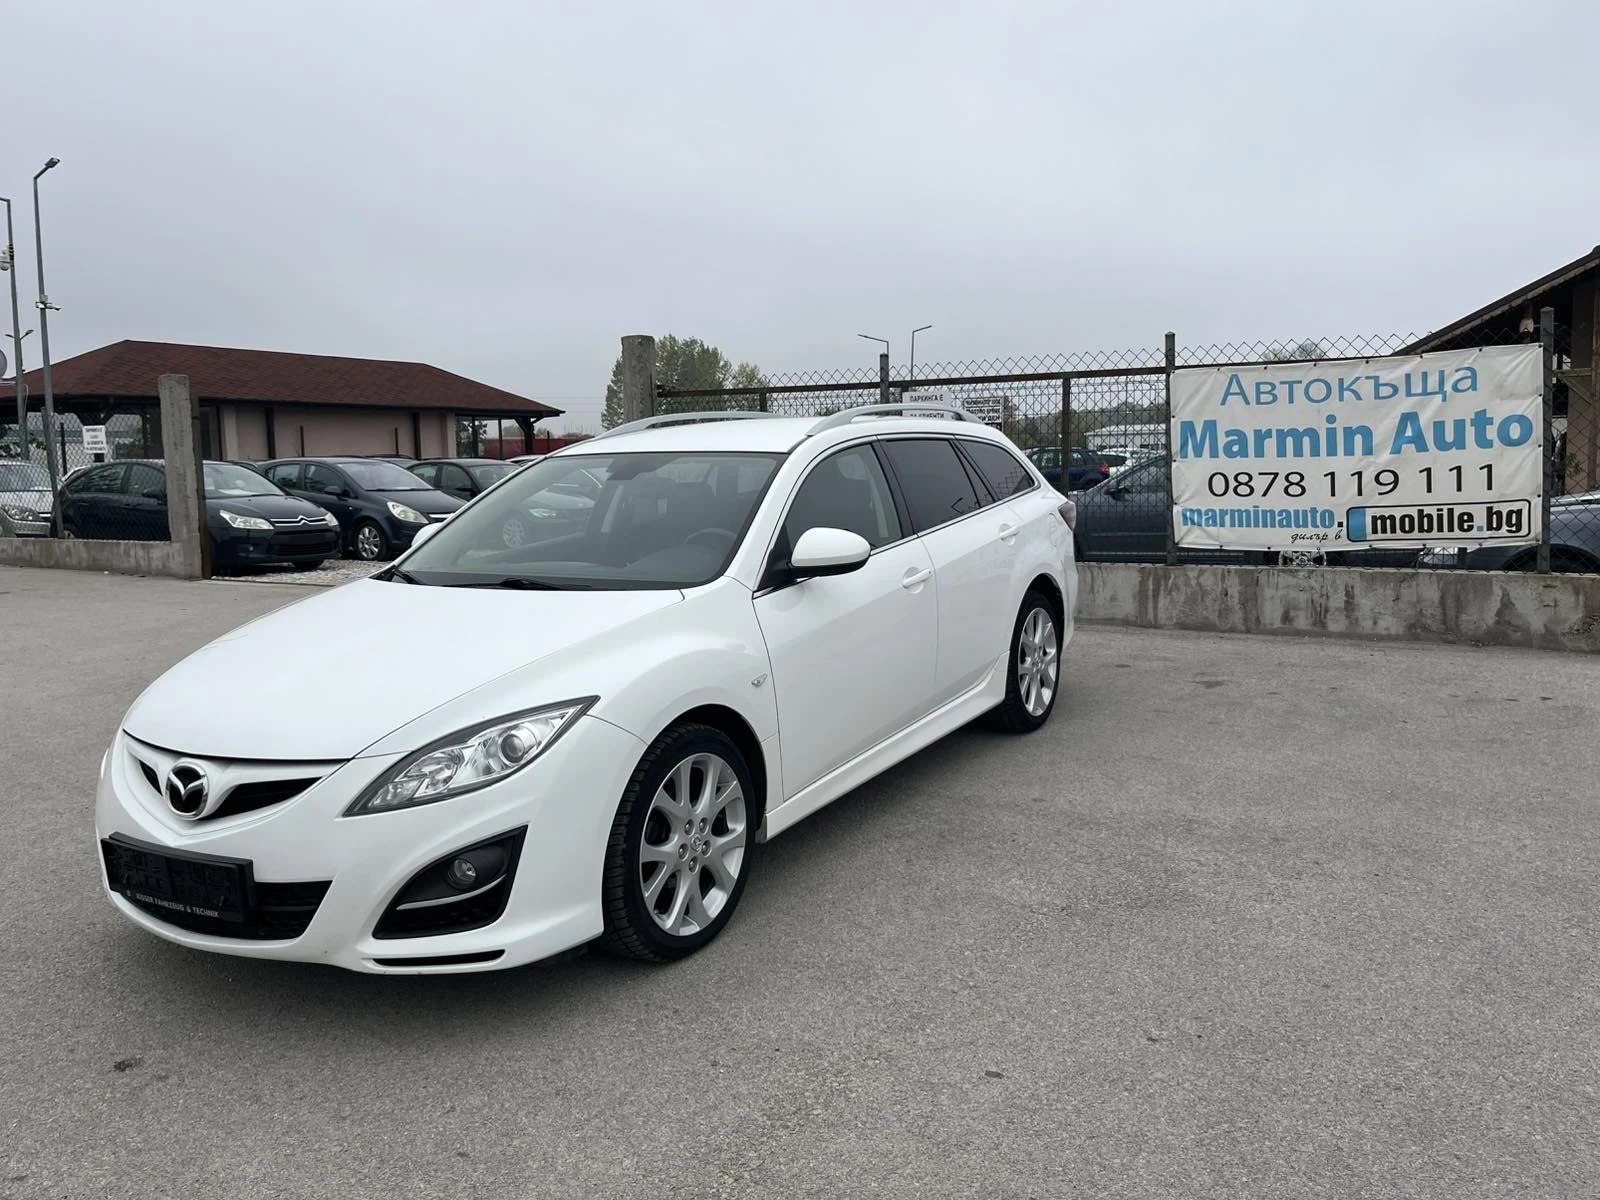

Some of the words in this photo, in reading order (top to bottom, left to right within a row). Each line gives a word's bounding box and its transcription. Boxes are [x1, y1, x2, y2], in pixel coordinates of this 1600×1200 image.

[1220, 365, 1478, 406] Автокъща
[1179, 414, 1374, 459] Marmin
[1389, 408, 1533, 456] Auto
[1207, 471, 1307, 497] 0878
[1323, 469, 1400, 497] 119
[1418, 463, 1494, 494] 111
